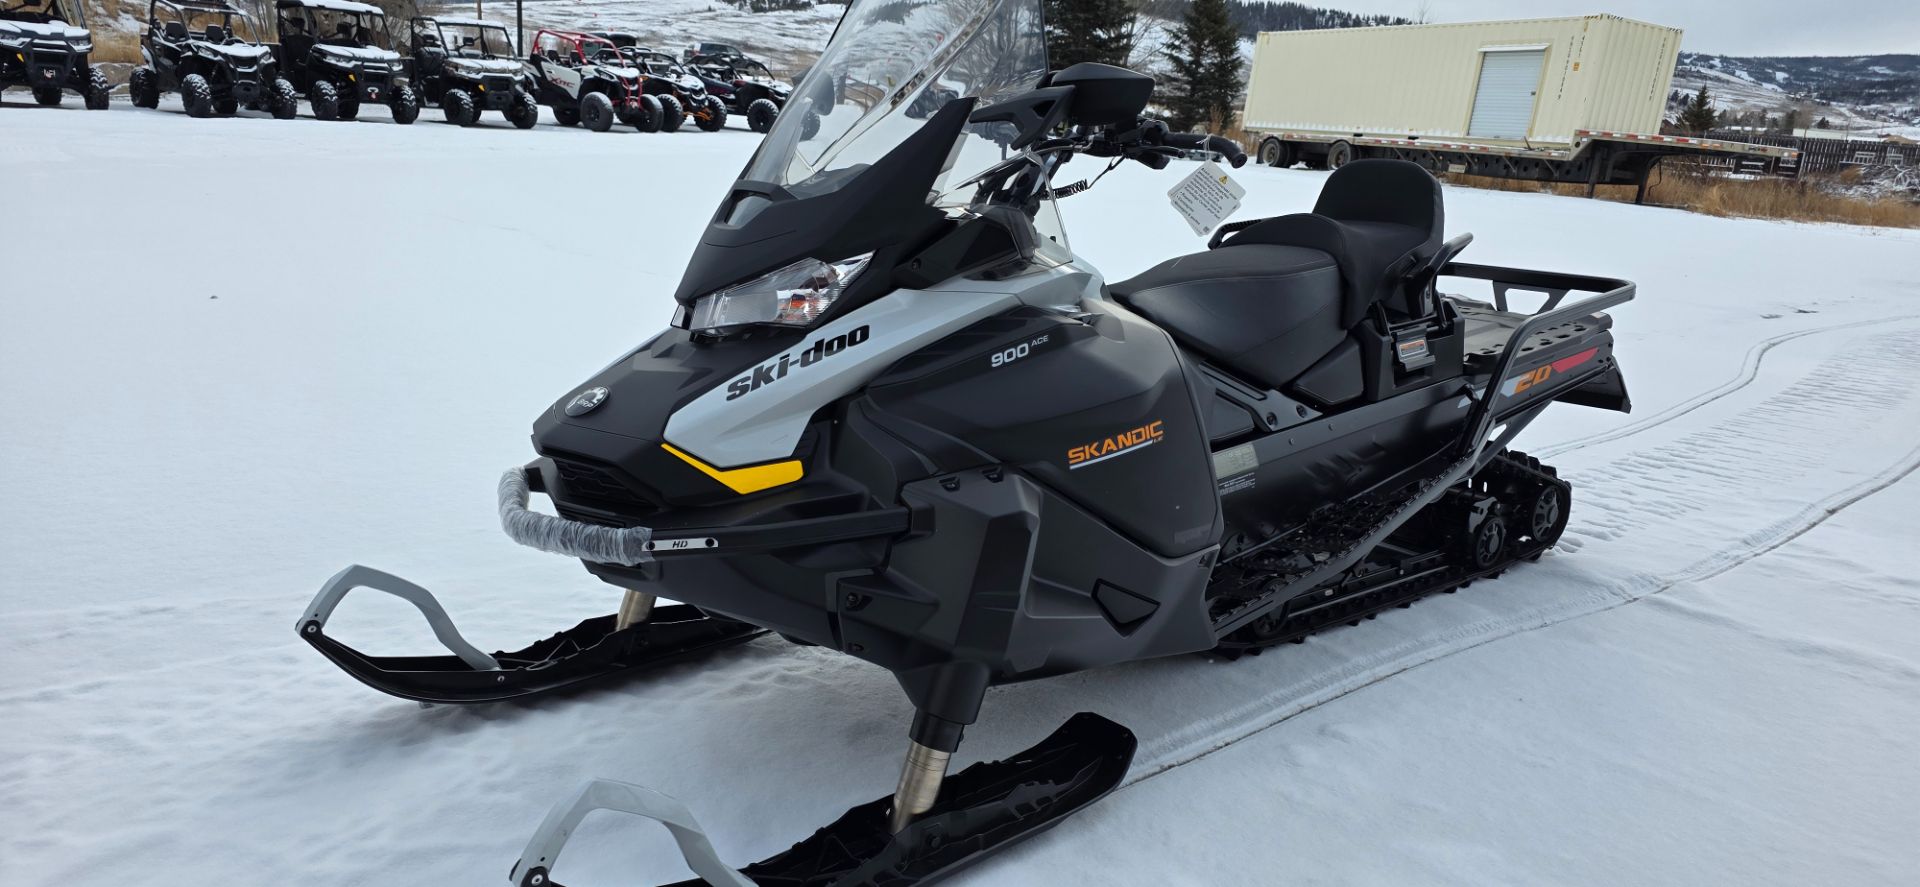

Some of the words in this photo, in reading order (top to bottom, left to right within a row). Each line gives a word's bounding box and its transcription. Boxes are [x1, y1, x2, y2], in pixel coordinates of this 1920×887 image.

[726, 325, 870, 401] ski-doo
[991, 343, 1029, 368] 900
[1031, 334, 1049, 347] ACE
[1068, 420, 1164, 465] SKANDIC
[672, 540, 688, 549] HD
